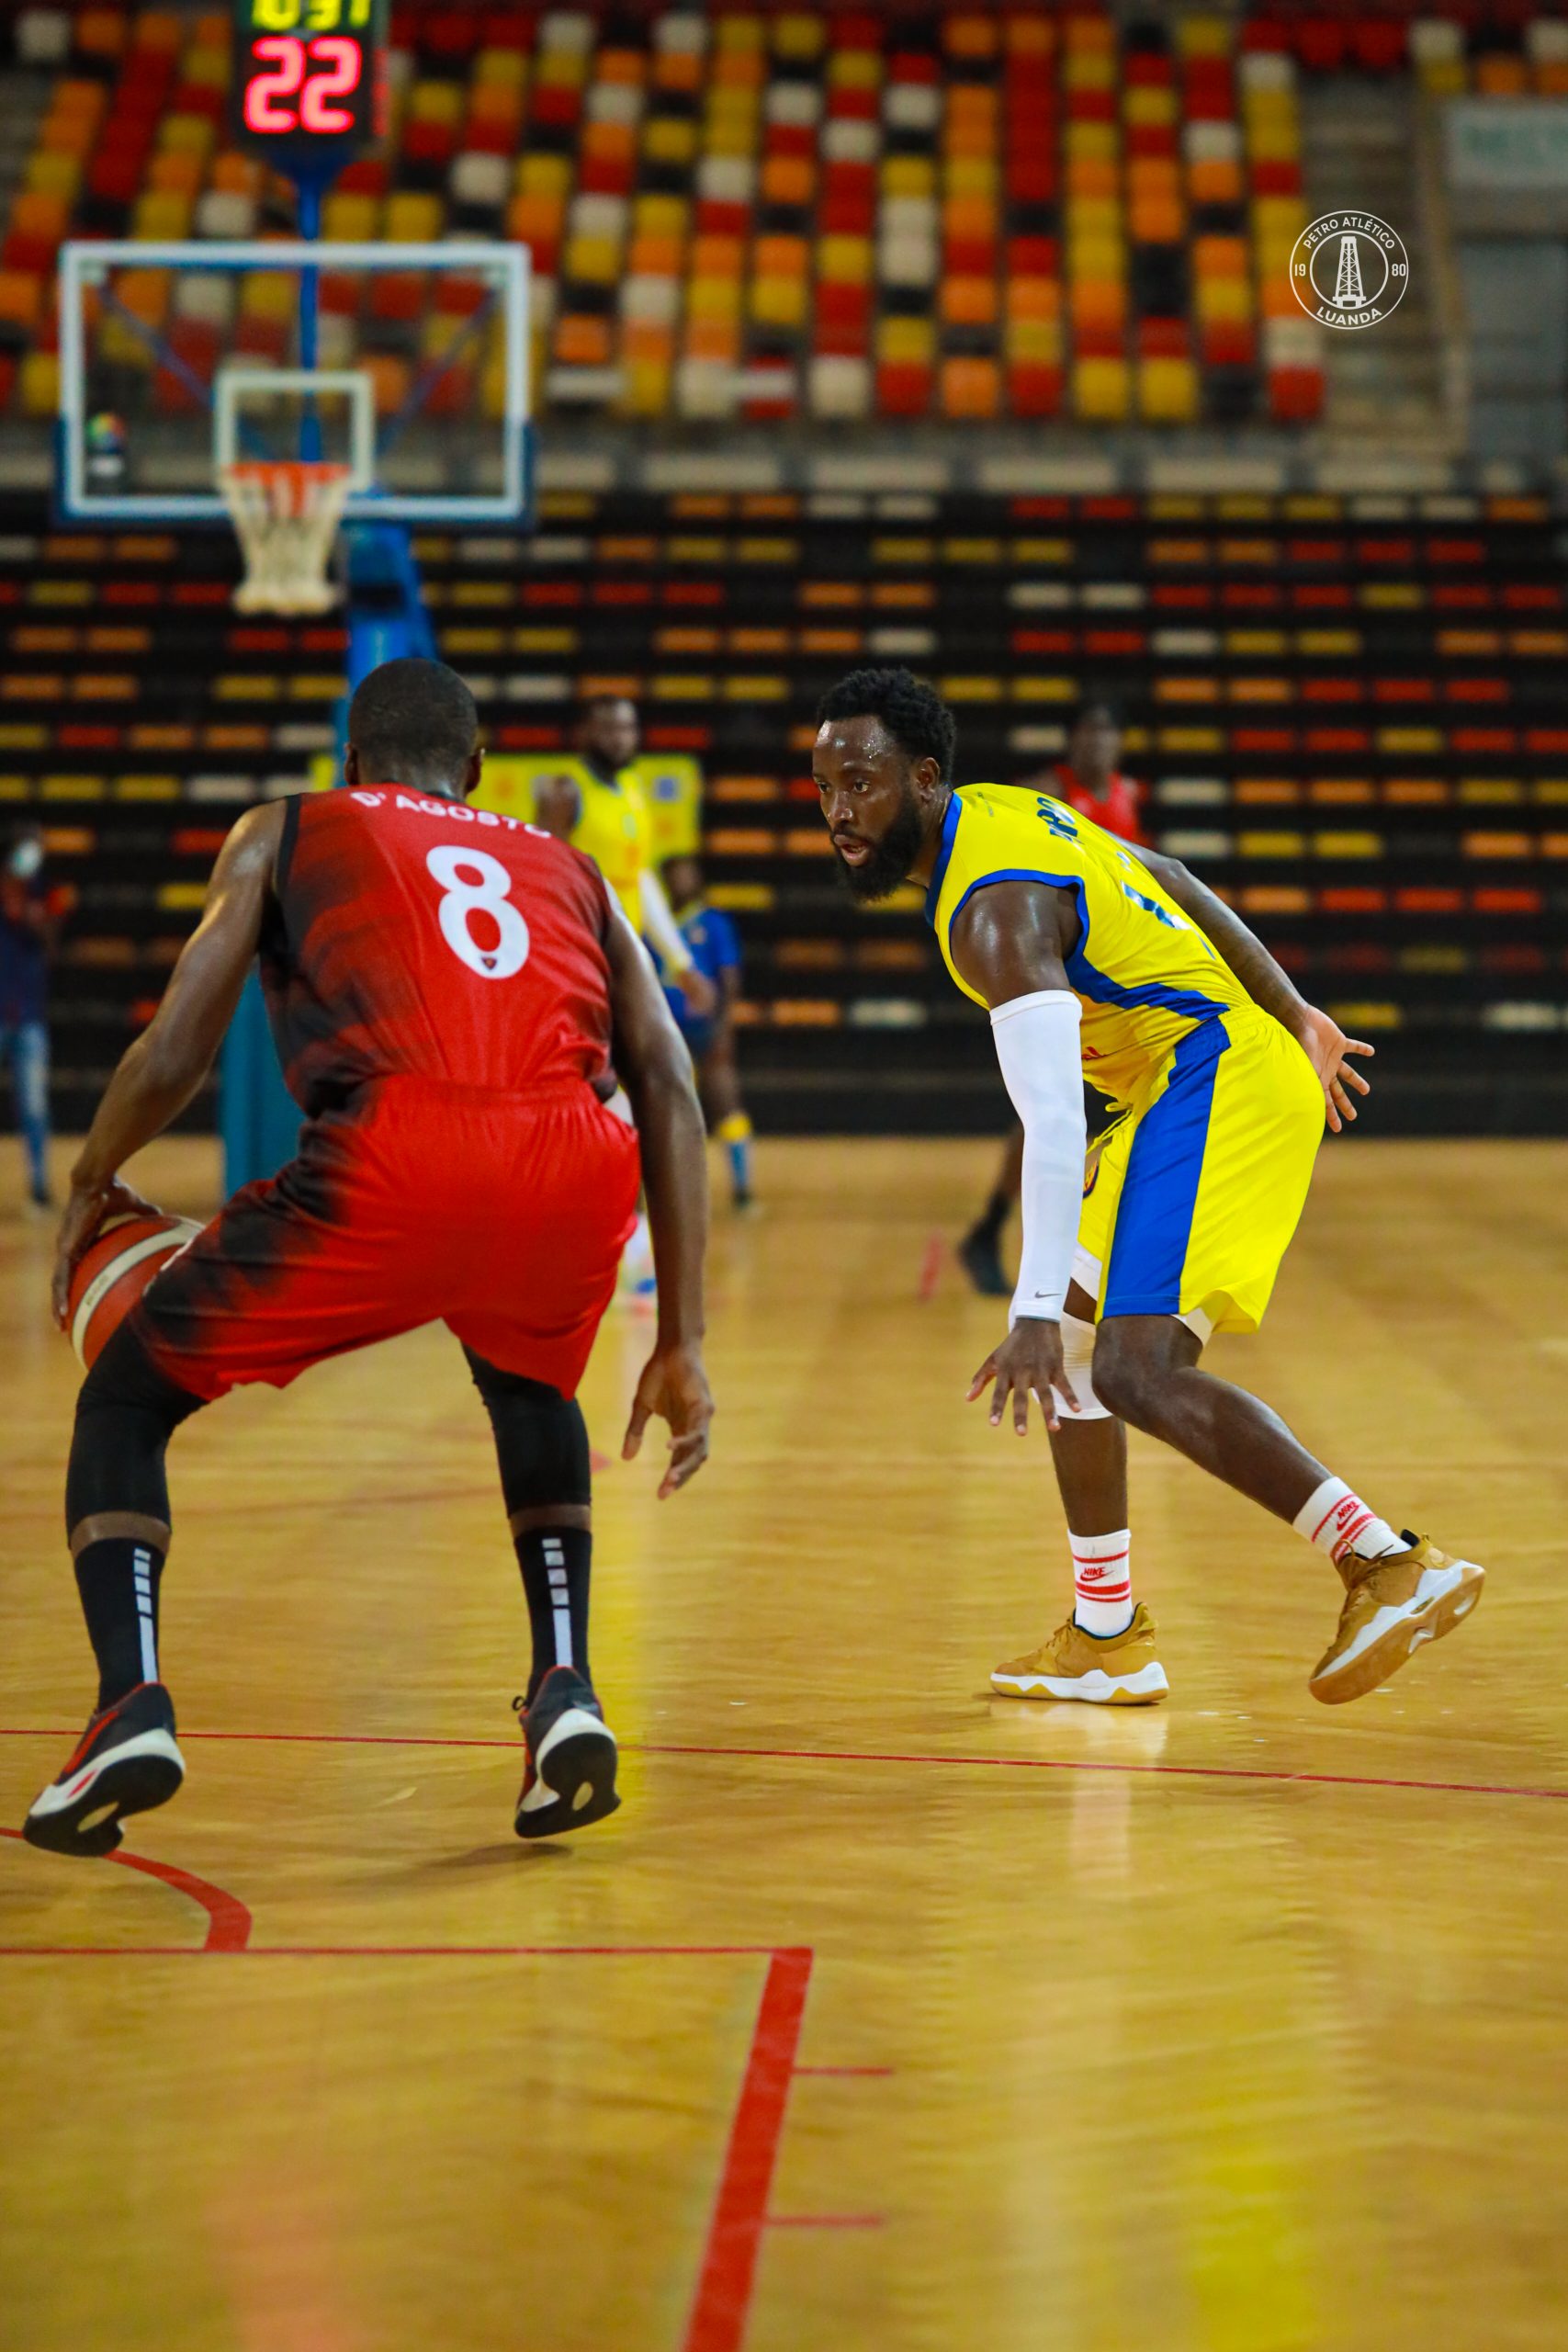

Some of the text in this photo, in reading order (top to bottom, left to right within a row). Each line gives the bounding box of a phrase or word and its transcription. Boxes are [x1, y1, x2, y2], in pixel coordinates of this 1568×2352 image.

[243, 35, 363, 134] 22
[426, 845, 530, 979] 8
[1084, 1566, 1106, 1576] NIKE
